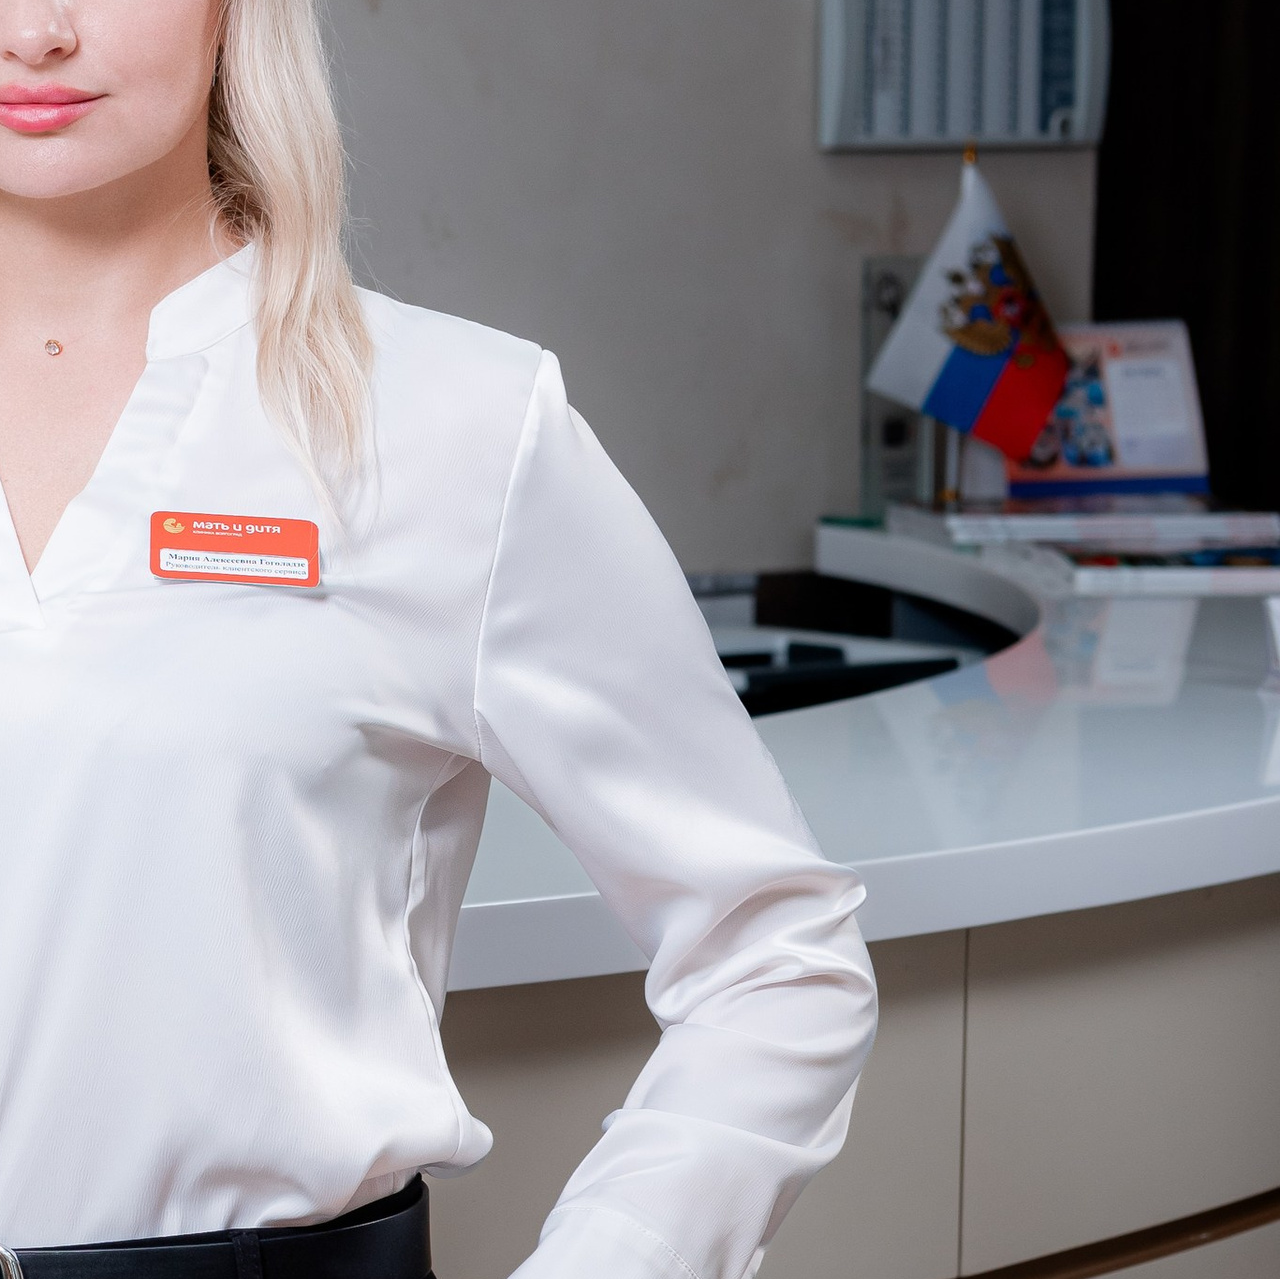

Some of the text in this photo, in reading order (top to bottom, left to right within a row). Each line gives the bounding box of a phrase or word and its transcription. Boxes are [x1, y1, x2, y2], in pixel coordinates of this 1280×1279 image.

[192, 521, 281, 534] мать и дитя
[168, 553, 200, 562] Мария
[203, 556, 257, 565] Алексеевна
[165, 561, 220, 570] Руководитель
[222, 566, 272, 574] клиентского
